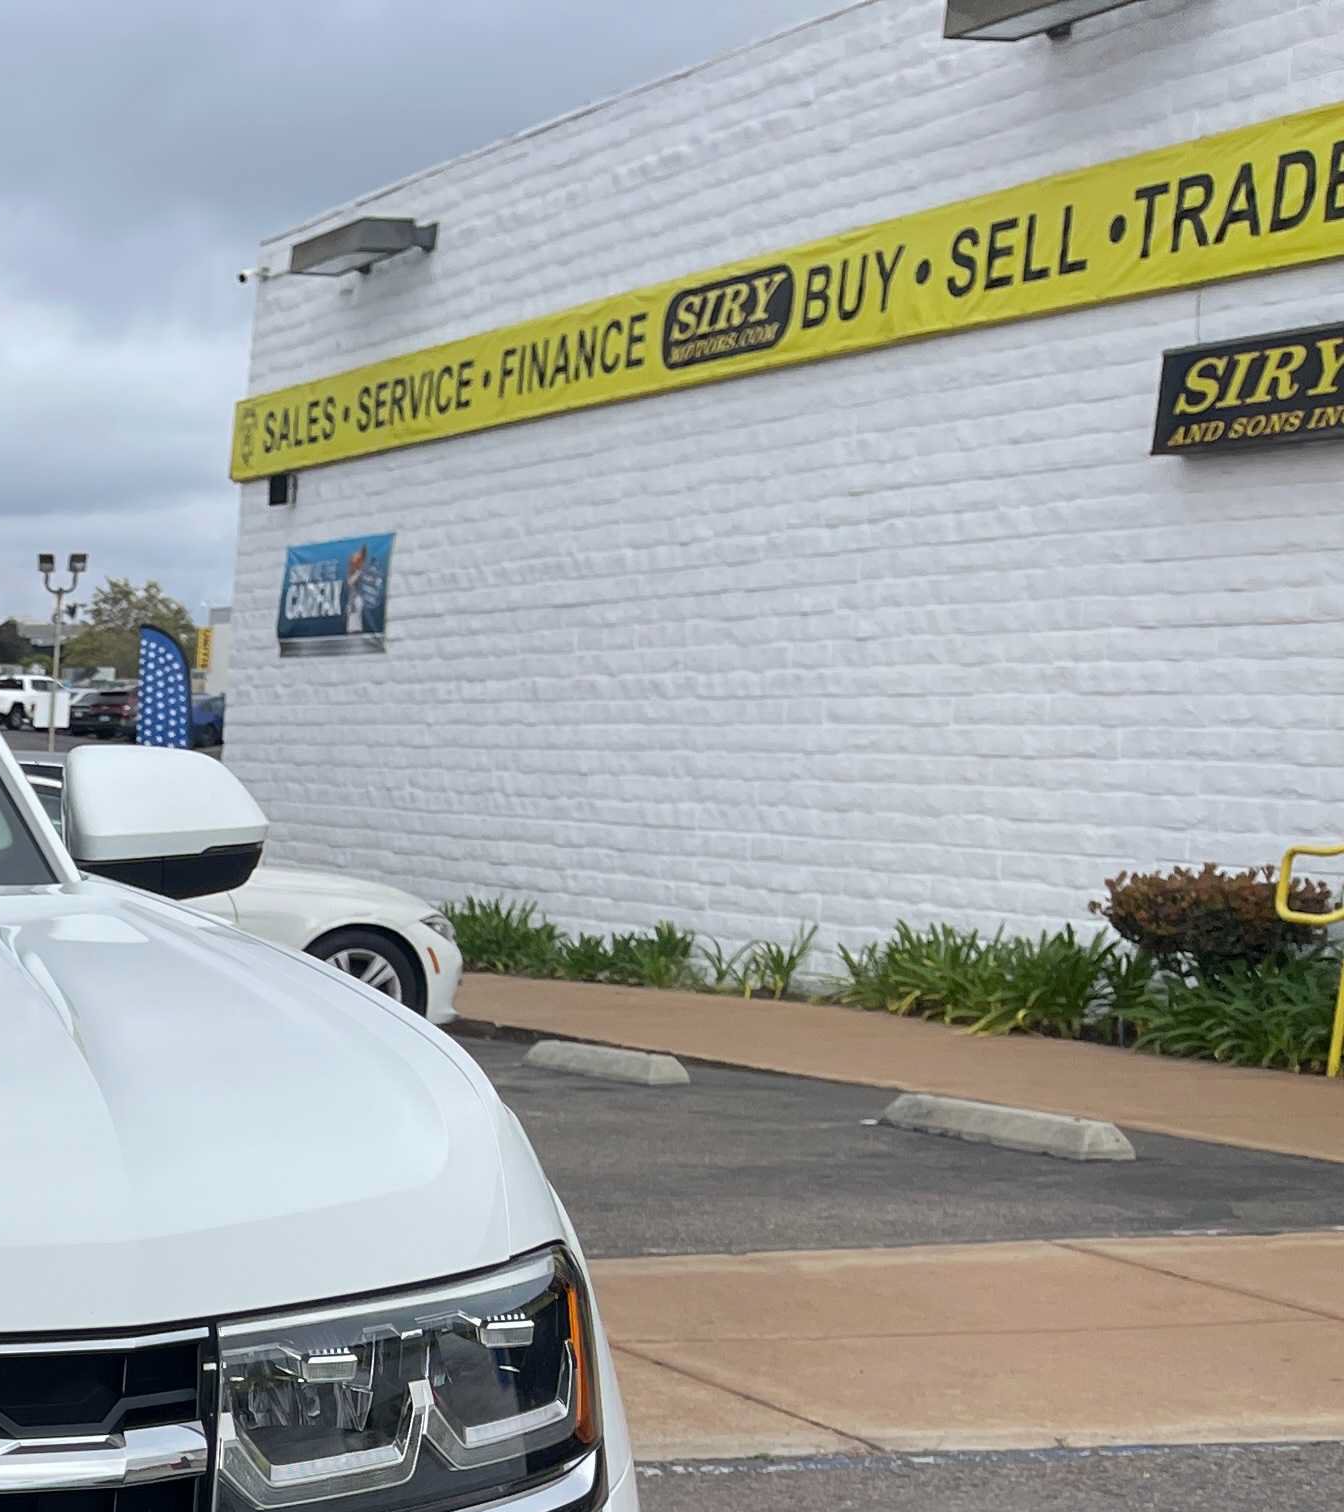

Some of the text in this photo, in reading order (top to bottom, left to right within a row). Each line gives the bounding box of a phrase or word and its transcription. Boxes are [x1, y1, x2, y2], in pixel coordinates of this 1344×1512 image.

[670, 272, 787, 340] SIRY
[800, 244, 905, 329] BUY
[946, 205, 1088, 298] SELL
[262, 312, 649, 453] SALES SERVICE FINANCE
[1173, 337, 1344, 416] SIRY
[1167, 420, 1225, 448] AND
[1228, 410, 1305, 439] SONS
